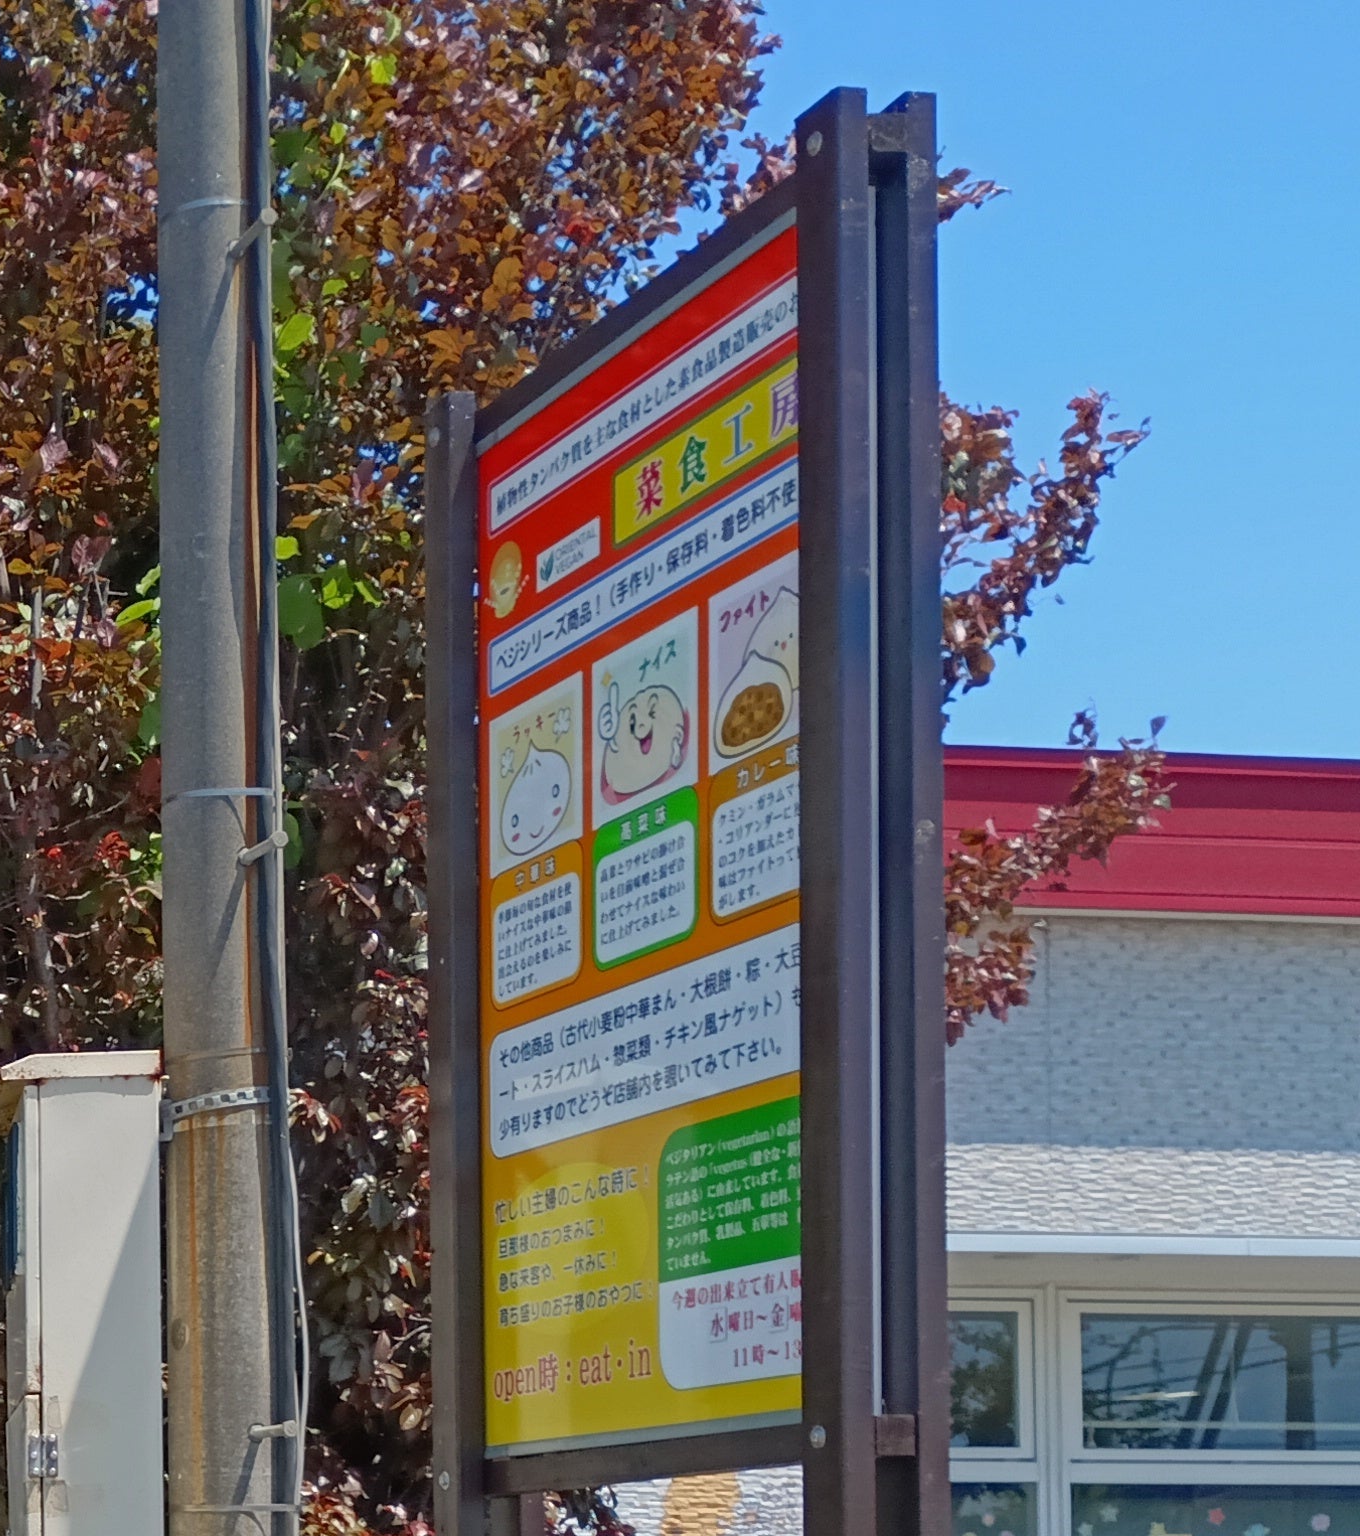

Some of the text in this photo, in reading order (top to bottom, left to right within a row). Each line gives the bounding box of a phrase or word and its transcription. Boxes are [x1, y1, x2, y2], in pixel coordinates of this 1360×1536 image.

[636, 367, 798, 523] 菜食工房
[555, 523, 596, 562] ORIENTAL
[555, 547, 583, 576] VEGAN
[719, 585, 770, 638] ファイト
[638, 637, 676, 681] ナイス
[512, 705, 555, 745] ラッキー
